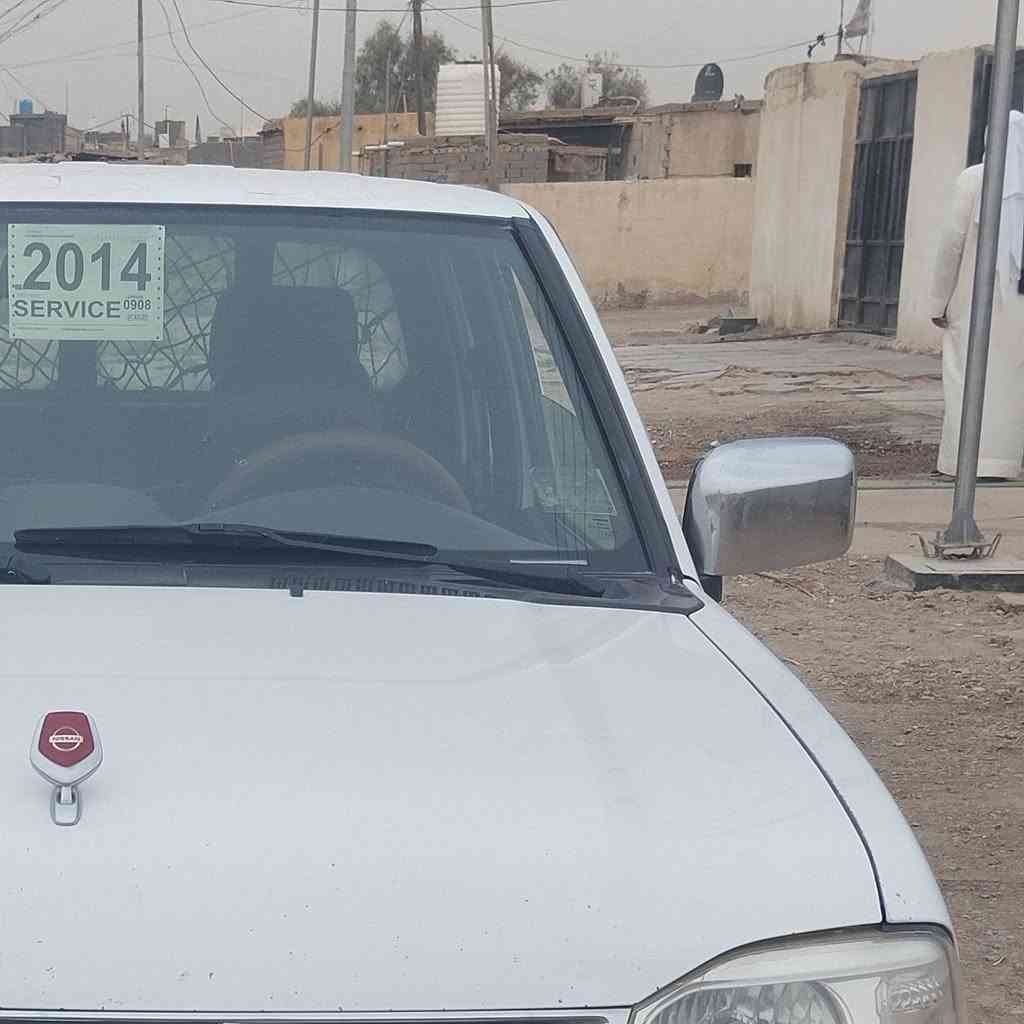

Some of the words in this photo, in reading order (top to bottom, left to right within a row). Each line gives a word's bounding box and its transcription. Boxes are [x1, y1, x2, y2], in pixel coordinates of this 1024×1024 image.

[23, 242, 152, 292] 2014
[14, 300, 121, 319] SERVICE
[123, 299, 152, 310] 0908
